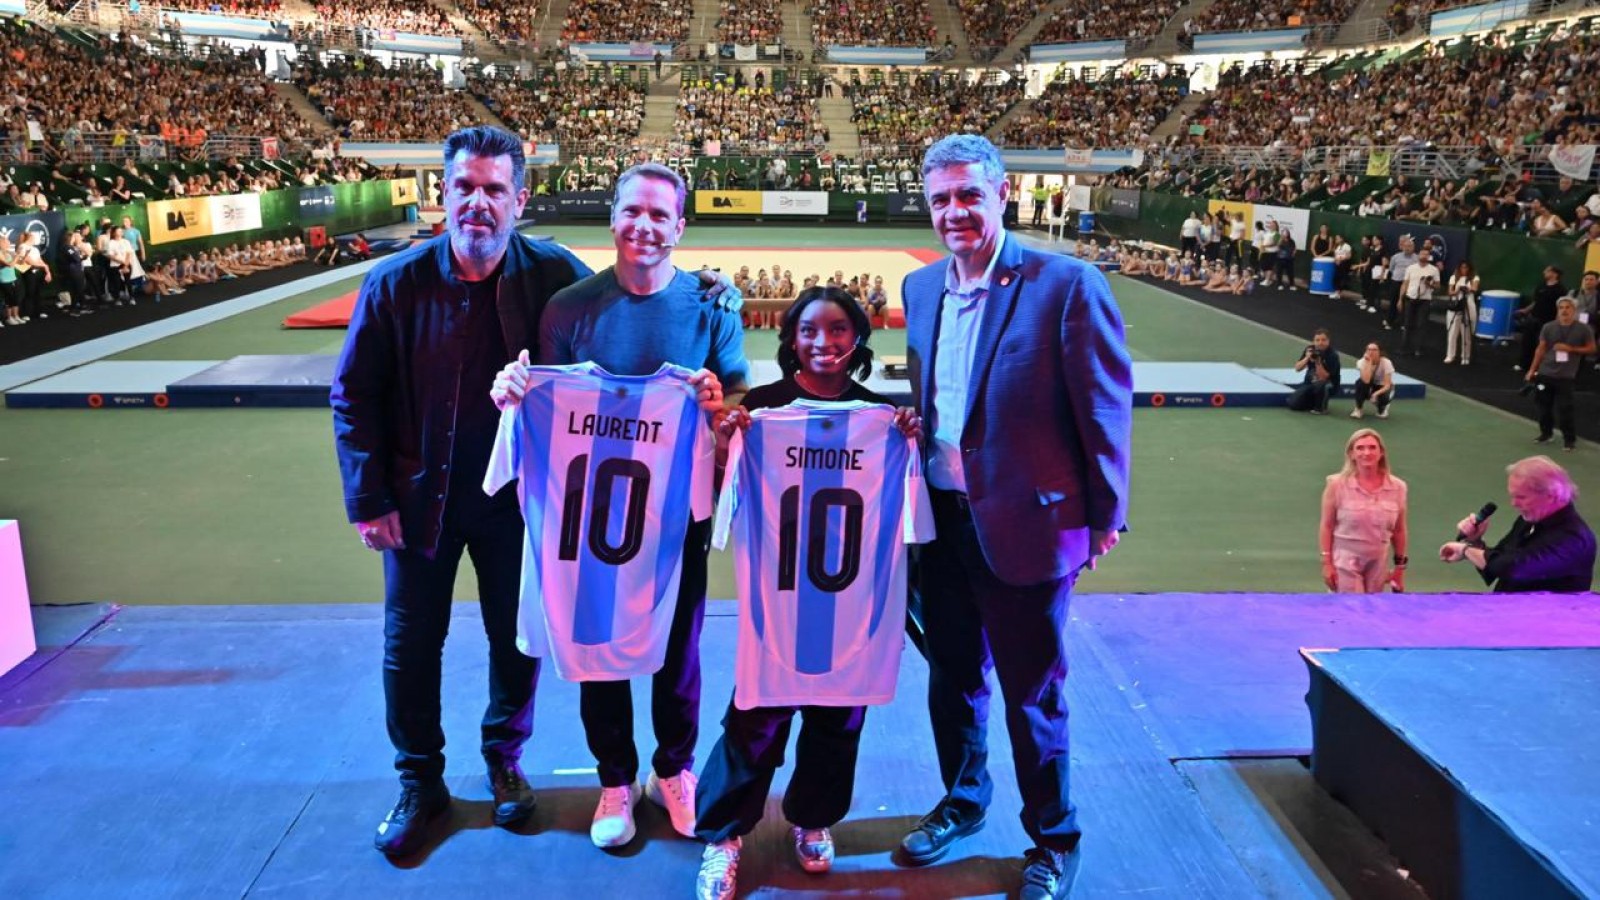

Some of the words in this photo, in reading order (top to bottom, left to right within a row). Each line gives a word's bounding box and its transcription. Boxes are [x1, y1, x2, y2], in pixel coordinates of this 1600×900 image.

[713, 197, 732, 208] BA
[166, 211, 186, 231] BA
[568, 411, 663, 443] LAURENT
[785, 446, 864, 470] SIMONE
[558, 453, 651, 566] 10
[778, 485, 864, 594] 10
